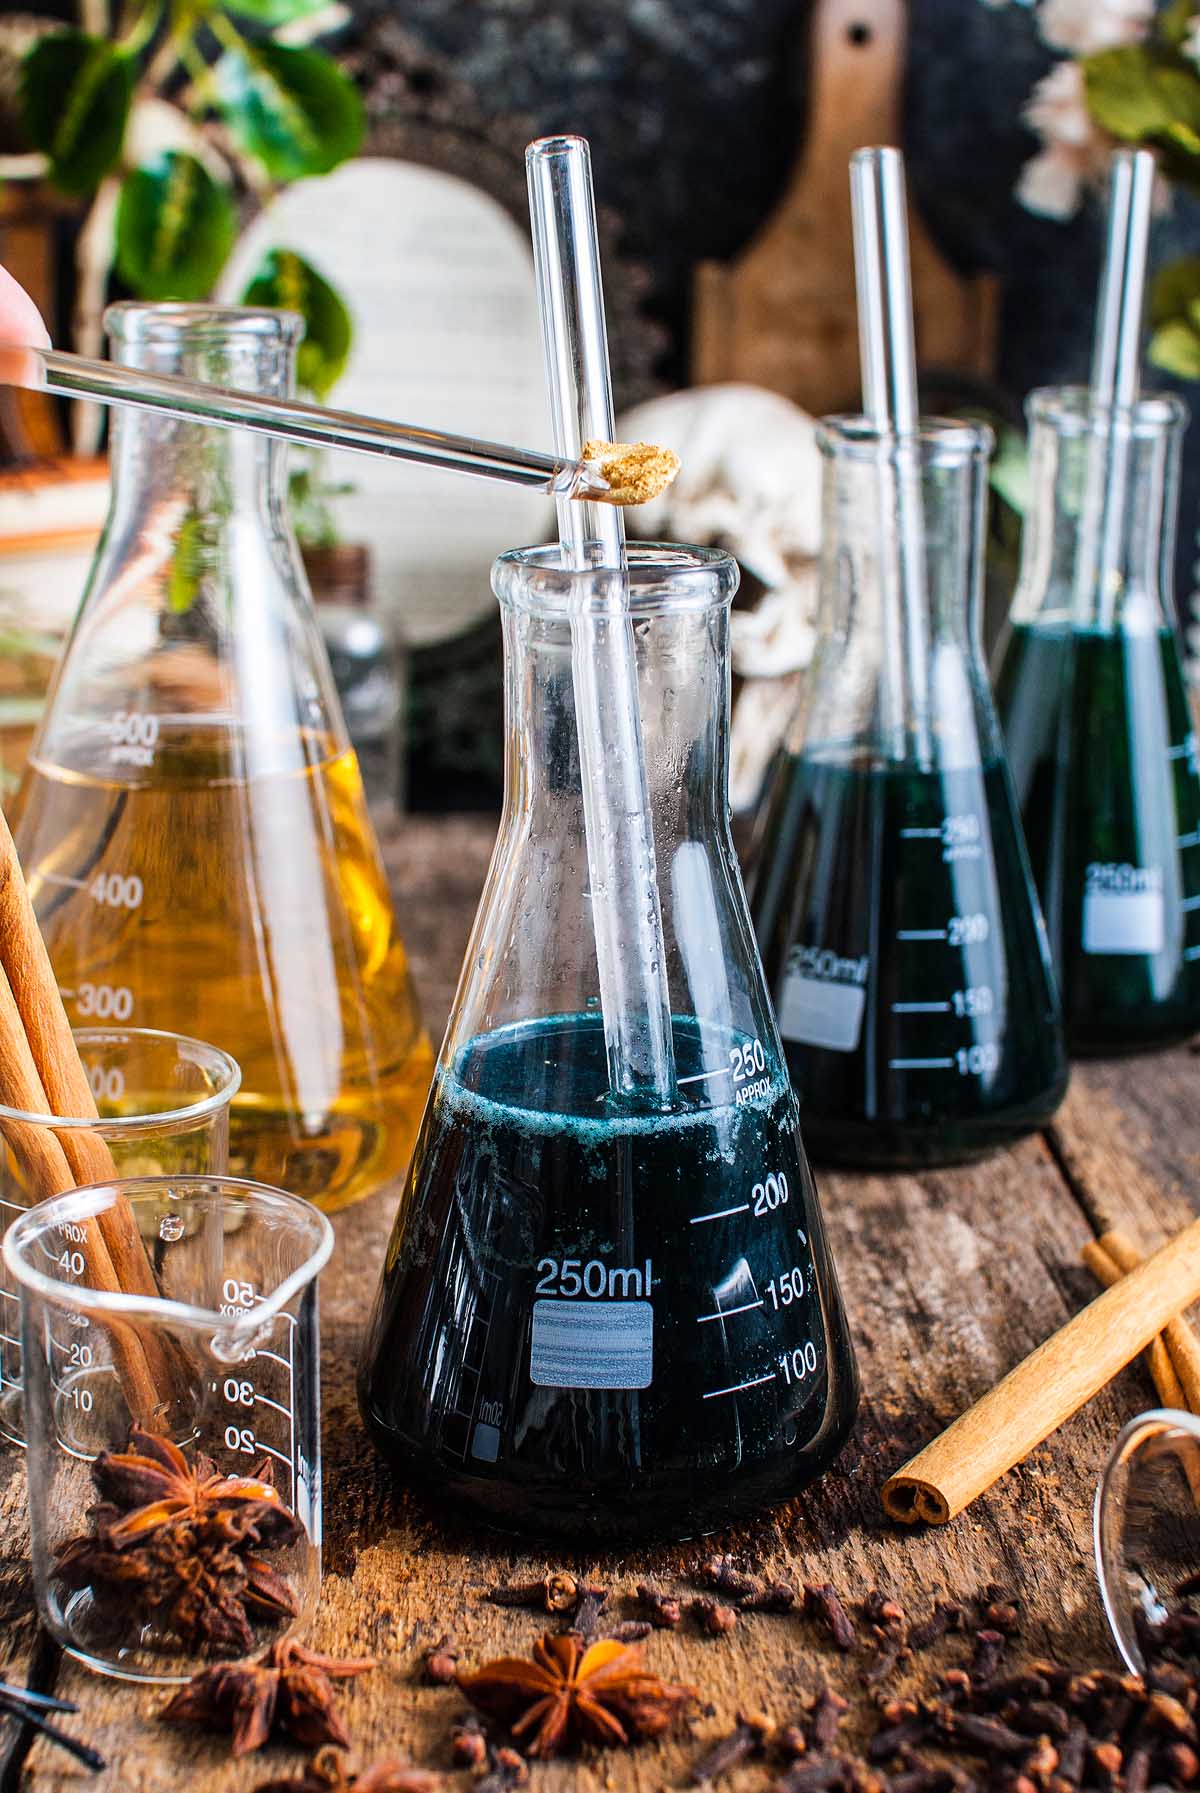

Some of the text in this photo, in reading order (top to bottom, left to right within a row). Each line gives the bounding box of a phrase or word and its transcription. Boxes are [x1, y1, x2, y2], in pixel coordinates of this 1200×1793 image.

[90, 872, 143, 909] 400
[76, 983, 133, 1020] 300
[728, 1038, 766, 1082] 250
[88, 1065, 125, 1101] 00
[735, 1075, 773, 1108] APPROX
[751, 1171, 789, 1217] 200
[59, 1250, 85, 1275] 40
[535, 1258, 653, 1298] 250ml
[765, 1267, 804, 1311] 150
[70, 1343, 93, 1367] 20
[779, 1341, 818, 1385] 100
[72, 1387, 93, 1412] 10
